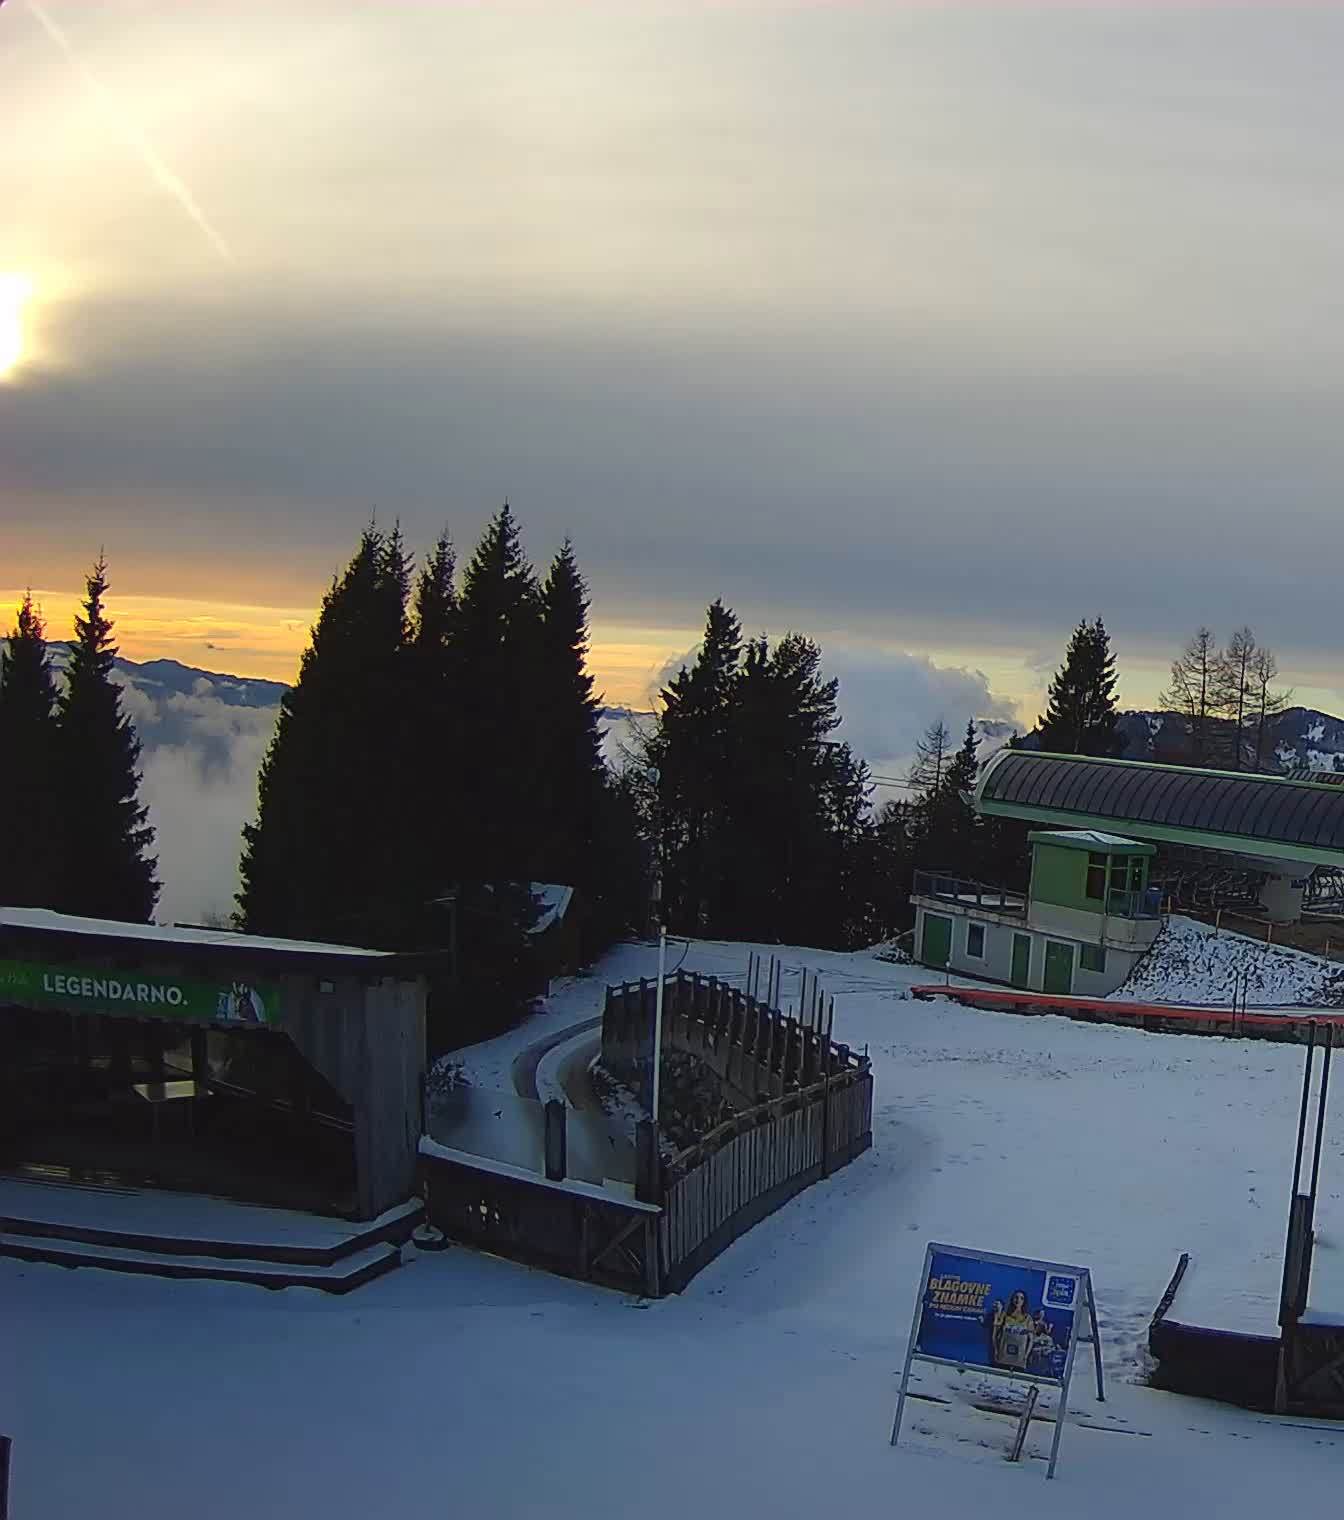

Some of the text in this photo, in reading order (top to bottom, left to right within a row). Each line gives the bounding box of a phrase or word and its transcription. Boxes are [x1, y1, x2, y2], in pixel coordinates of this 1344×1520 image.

[43, 974, 189, 1006] LEGENDARNO.
[929, 1278, 992, 1296] BLAGOVNE
[933, 1291, 985, 1307] ZNAMKE
